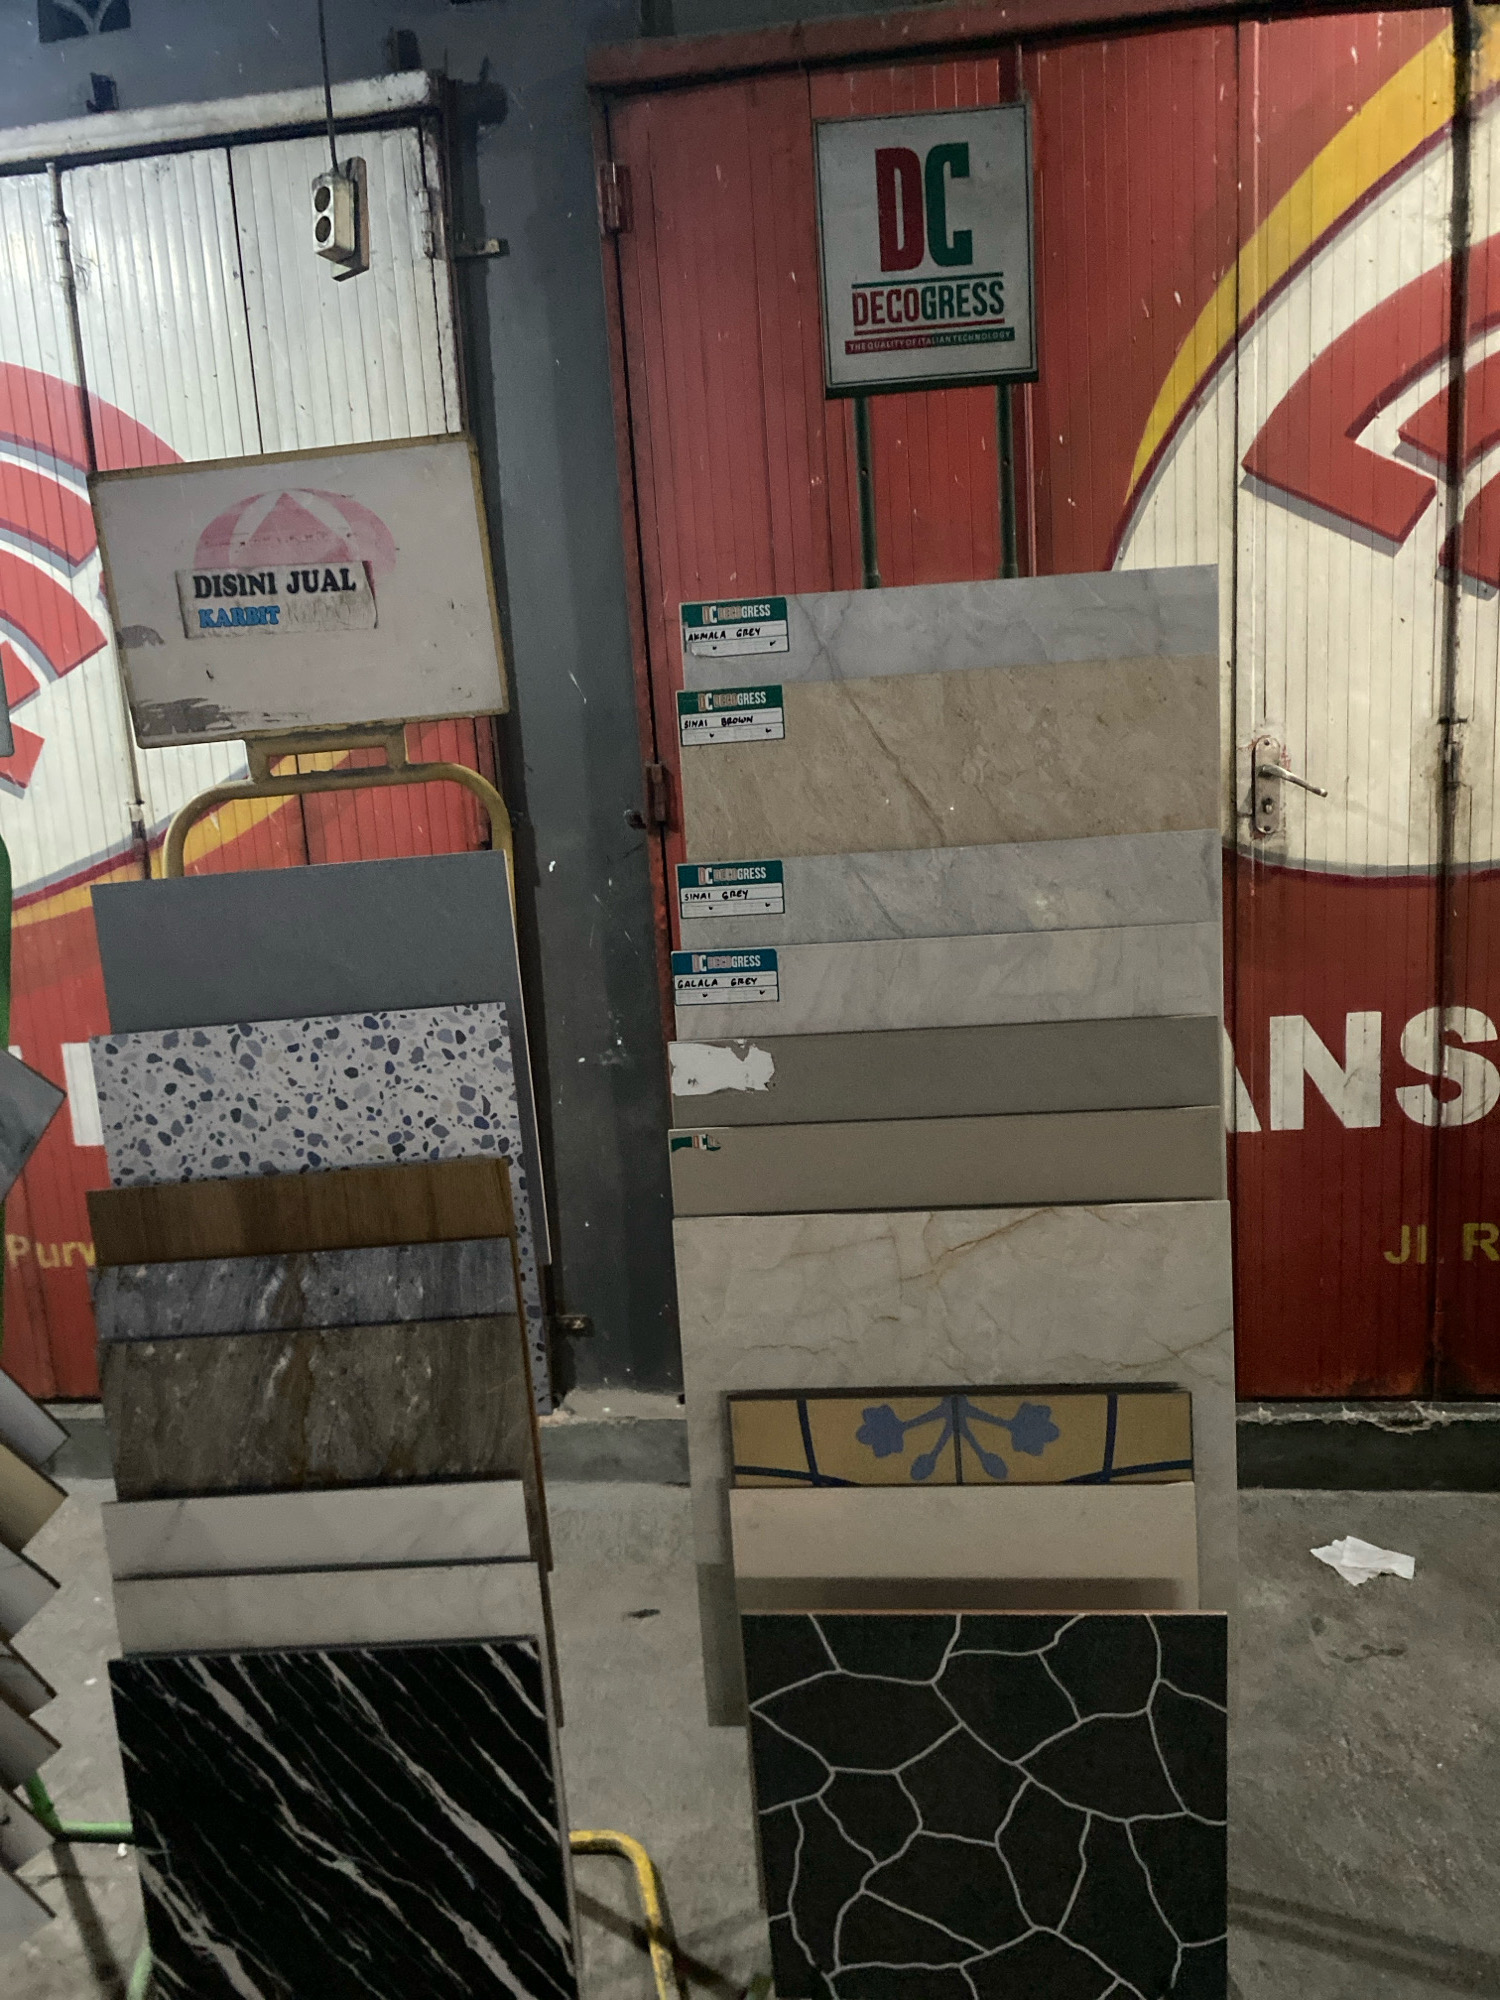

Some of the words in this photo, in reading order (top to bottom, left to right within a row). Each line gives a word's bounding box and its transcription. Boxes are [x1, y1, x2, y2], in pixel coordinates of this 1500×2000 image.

[875, 142, 973, 272] DC
[852, 280, 1005, 327] DECOGRESS
[850, 342, 866, 350] THE
[867, 338, 905, 349] QUALITY
[905, 338, 917, 346] OF
[917, 334, 951, 345] ITALIAN
[952, 330, 1011, 342] TECHNOLOGY
[193, 572, 278, 599] DISINI
[286, 568, 357, 594] JUAL
[198, 605, 281, 629] KARBIT
[736, 627, 761, 638] GREY
[684, 718, 708, 729] SINAI
[721, 715, 754, 727] BROWN
[684, 892, 711, 901] SINAI
[722, 889, 749, 899] GREY
[677, 978, 718, 989] GALALA
[731, 977, 758, 987] GREY
